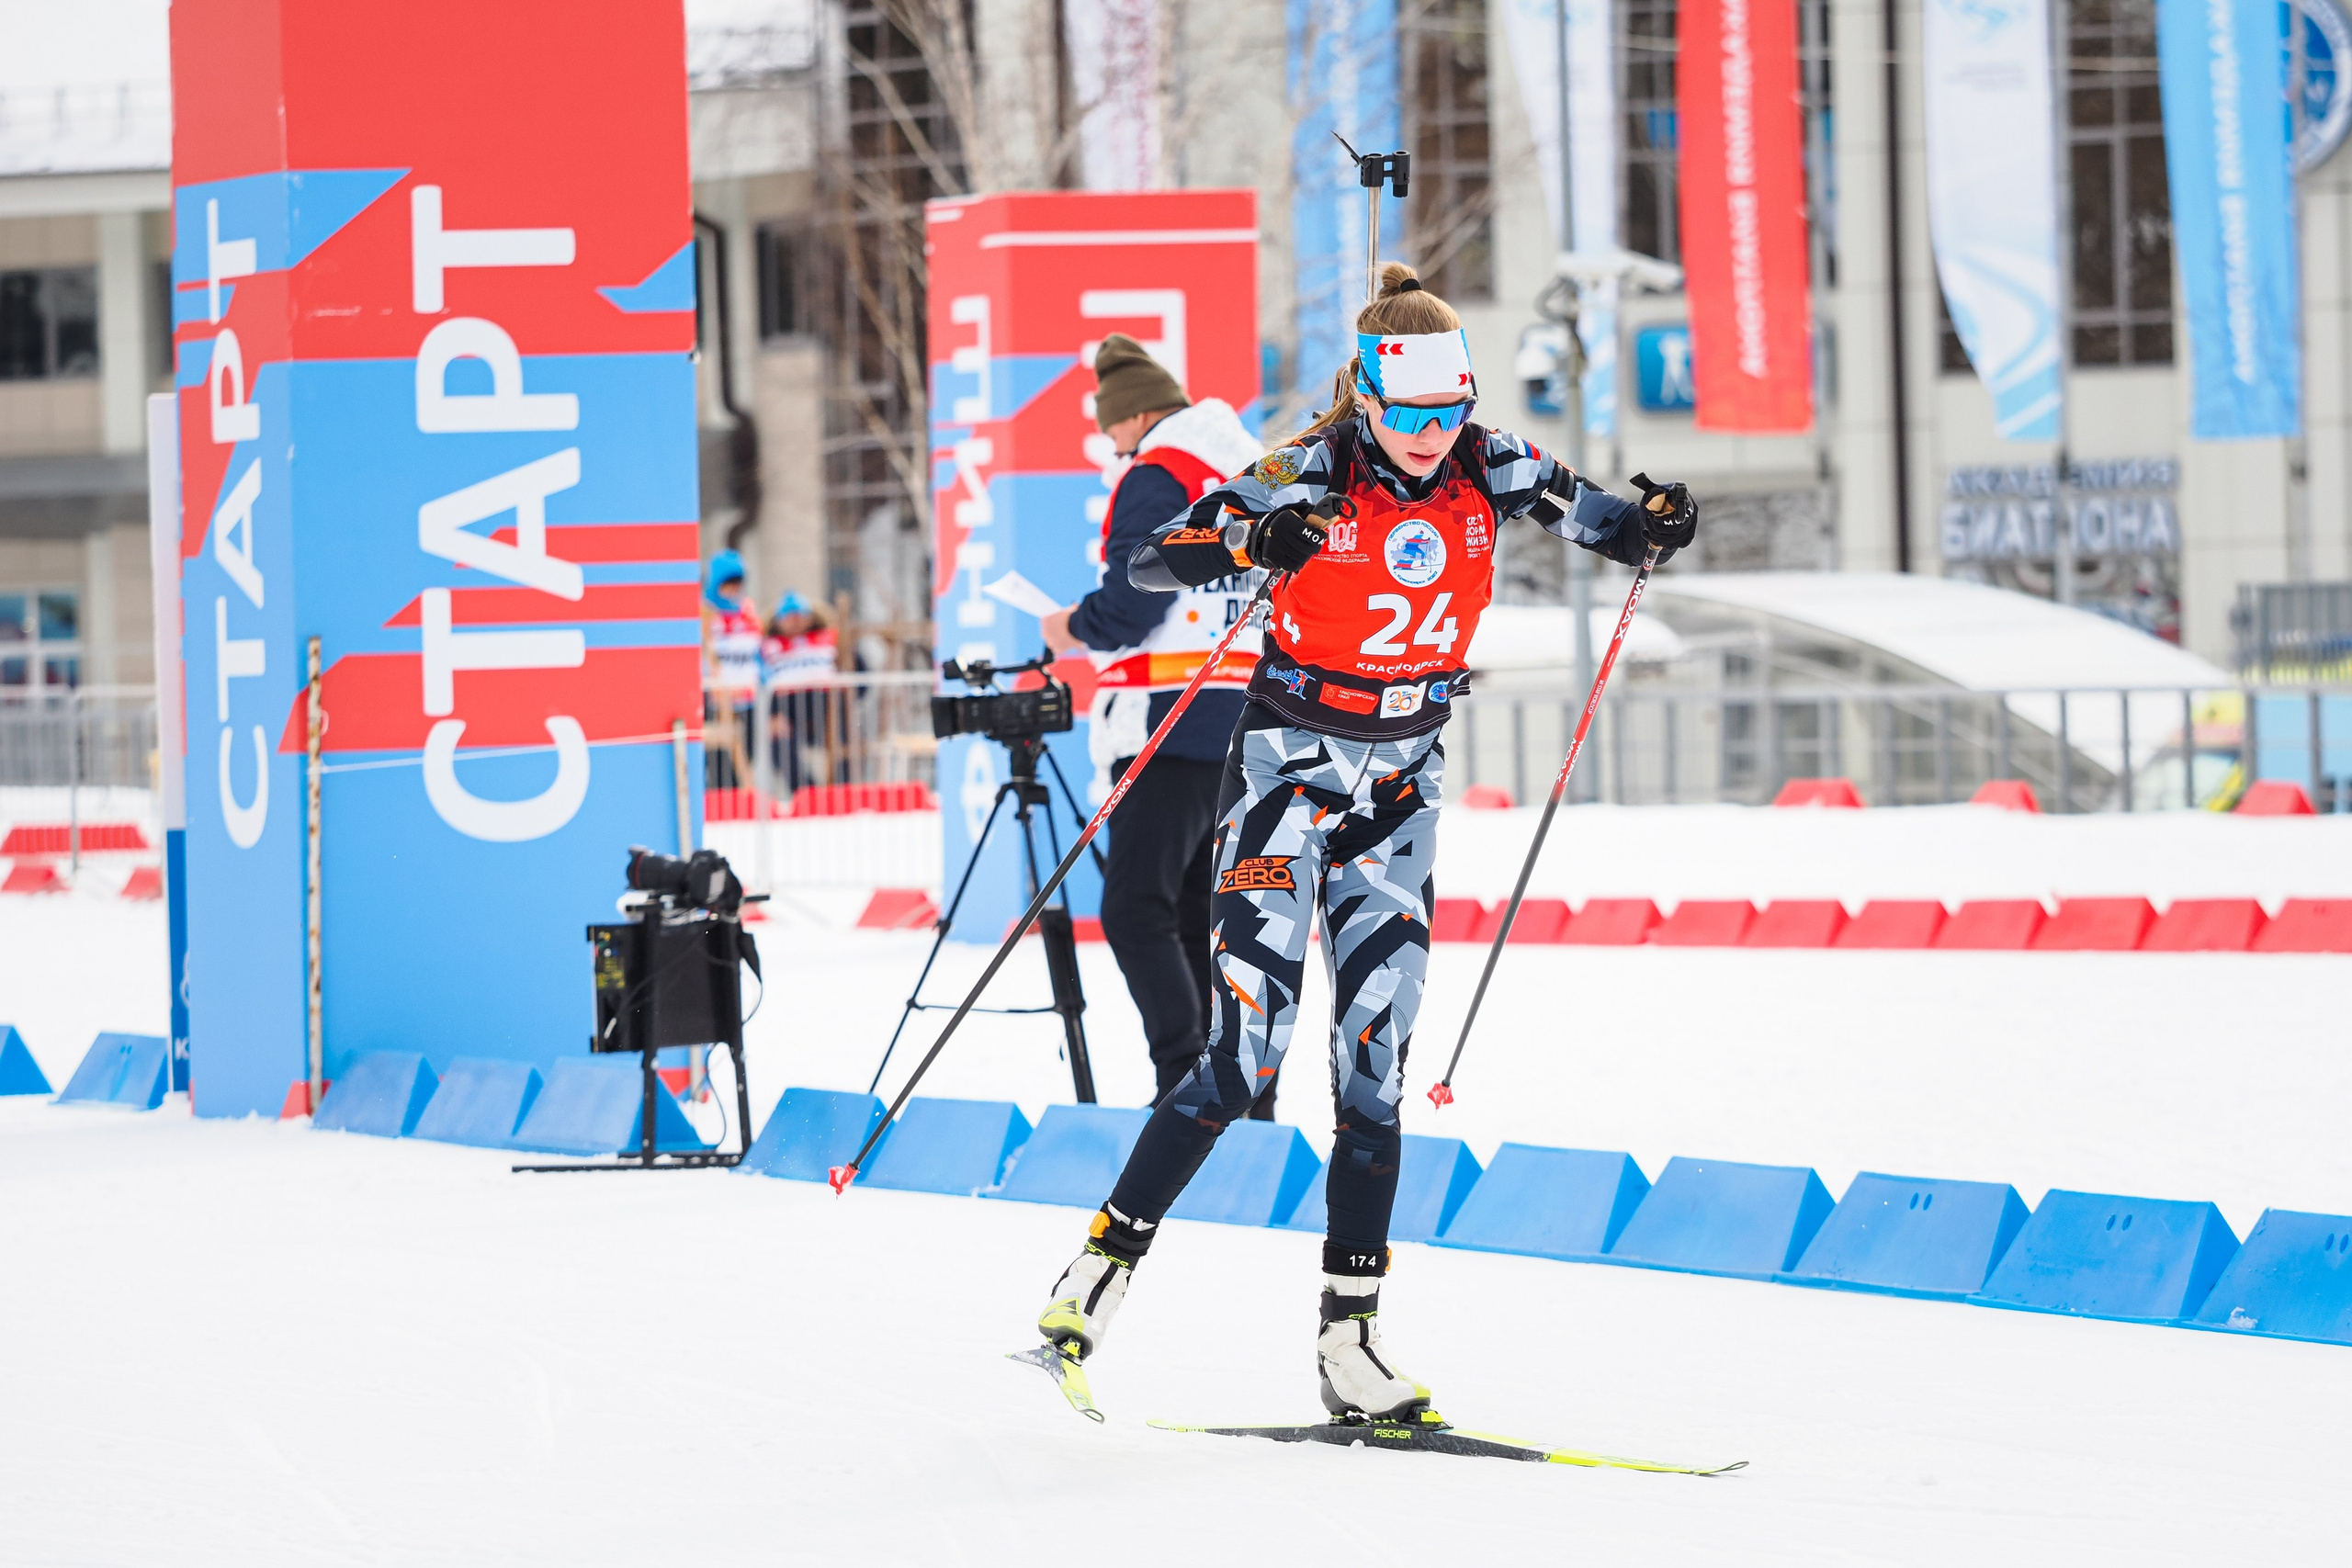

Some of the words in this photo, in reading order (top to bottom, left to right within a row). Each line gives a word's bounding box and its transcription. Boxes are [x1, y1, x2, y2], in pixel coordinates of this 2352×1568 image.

[207, 198, 268, 849] СТАРТ
[412, 185, 591, 843] СТАРТ
[950, 294, 996, 850] ФНИШ
[1359, 592, 1459, 657] 24
[1614, 577, 1646, 641] MOAX
[1356, 659, 1445, 675] КРАСНОЯРСК
[1556, 738, 1577, 784] MOAX
[1092, 778, 1133, 828] MOAX
[1217, 867, 1295, 895] ZERO
[1244, 858, 1274, 867] CLUB
[1085, 1242, 1129, 1269] SCHER
[1349, 1255, 1376, 1268] 174
[1374, 1428, 1412, 1439] FISCHER
